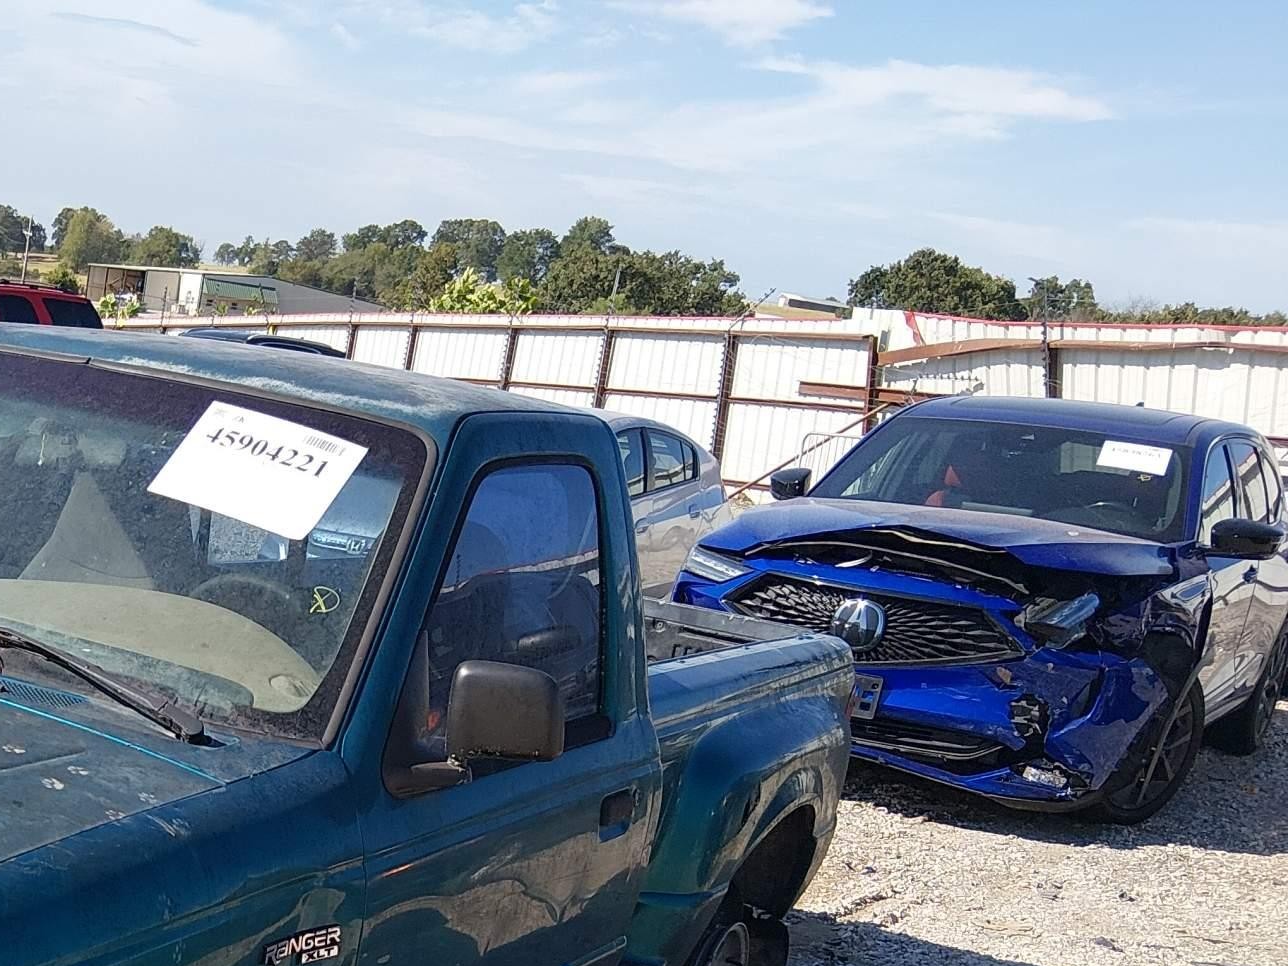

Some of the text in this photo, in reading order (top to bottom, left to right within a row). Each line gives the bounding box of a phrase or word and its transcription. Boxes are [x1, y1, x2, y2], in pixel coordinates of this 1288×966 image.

[206, 426, 329, 478] 45904221
[265, 926, 341, 965] RANGER
[302, 946, 338, 963] XLT
